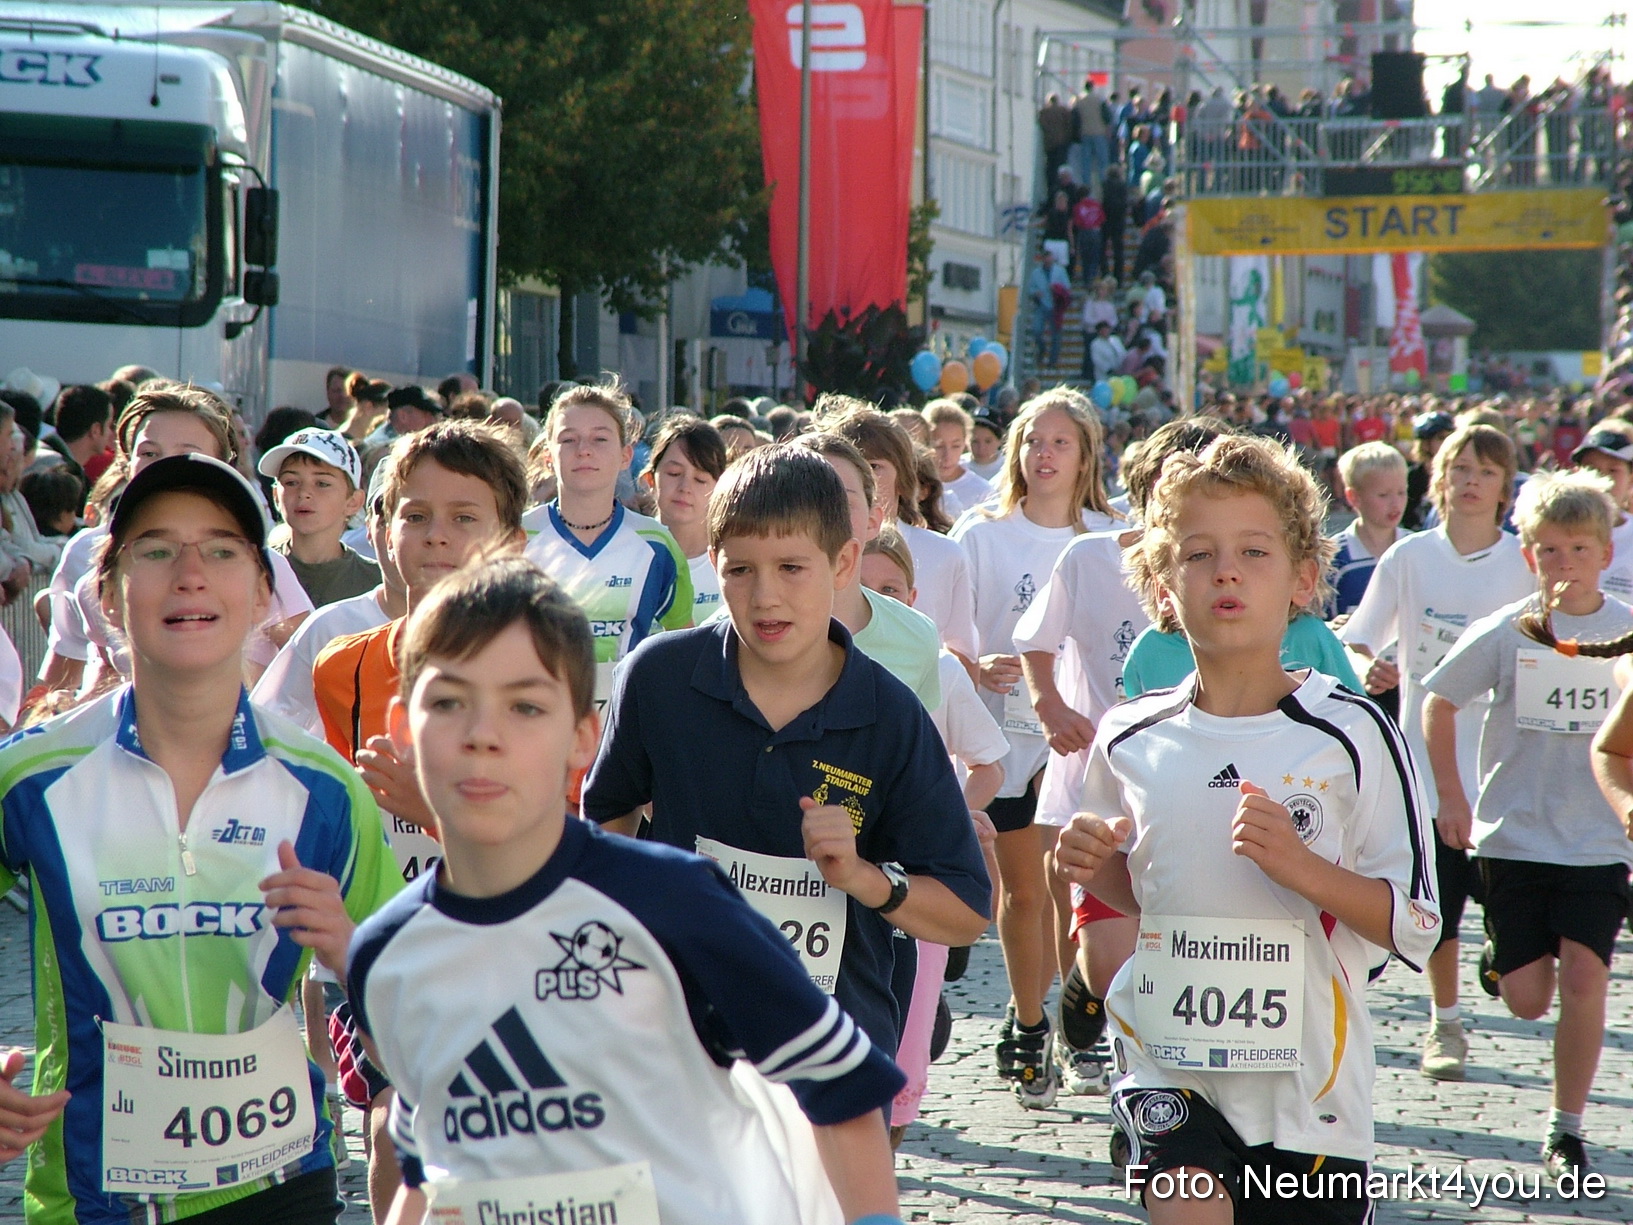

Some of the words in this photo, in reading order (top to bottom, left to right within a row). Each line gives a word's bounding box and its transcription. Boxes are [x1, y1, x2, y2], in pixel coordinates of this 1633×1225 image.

[1325, 204, 1466, 239] START
[1546, 687, 1609, 710] 4151
[825, 774, 870, 796] STADTLAUF
[100, 876, 175, 895] TEAM
[95, 901, 266, 942] BOCK
[1171, 930, 1290, 962] Maximilian
[1138, 974, 1154, 994] Ju
[1172, 985, 1288, 1030] 4045
[157, 1046, 258, 1079] Simone
[1230, 1048, 1298, 1061] PFLEIDERER
[112, 1090, 134, 1114] Ju
[163, 1086, 297, 1149] 4069
[444, 1090, 606, 1143] adidas
[107, 1167, 188, 1185] BOCK
[240, 1134, 312, 1174] PFLEIDERER
[477, 1197, 618, 1225] Christian
